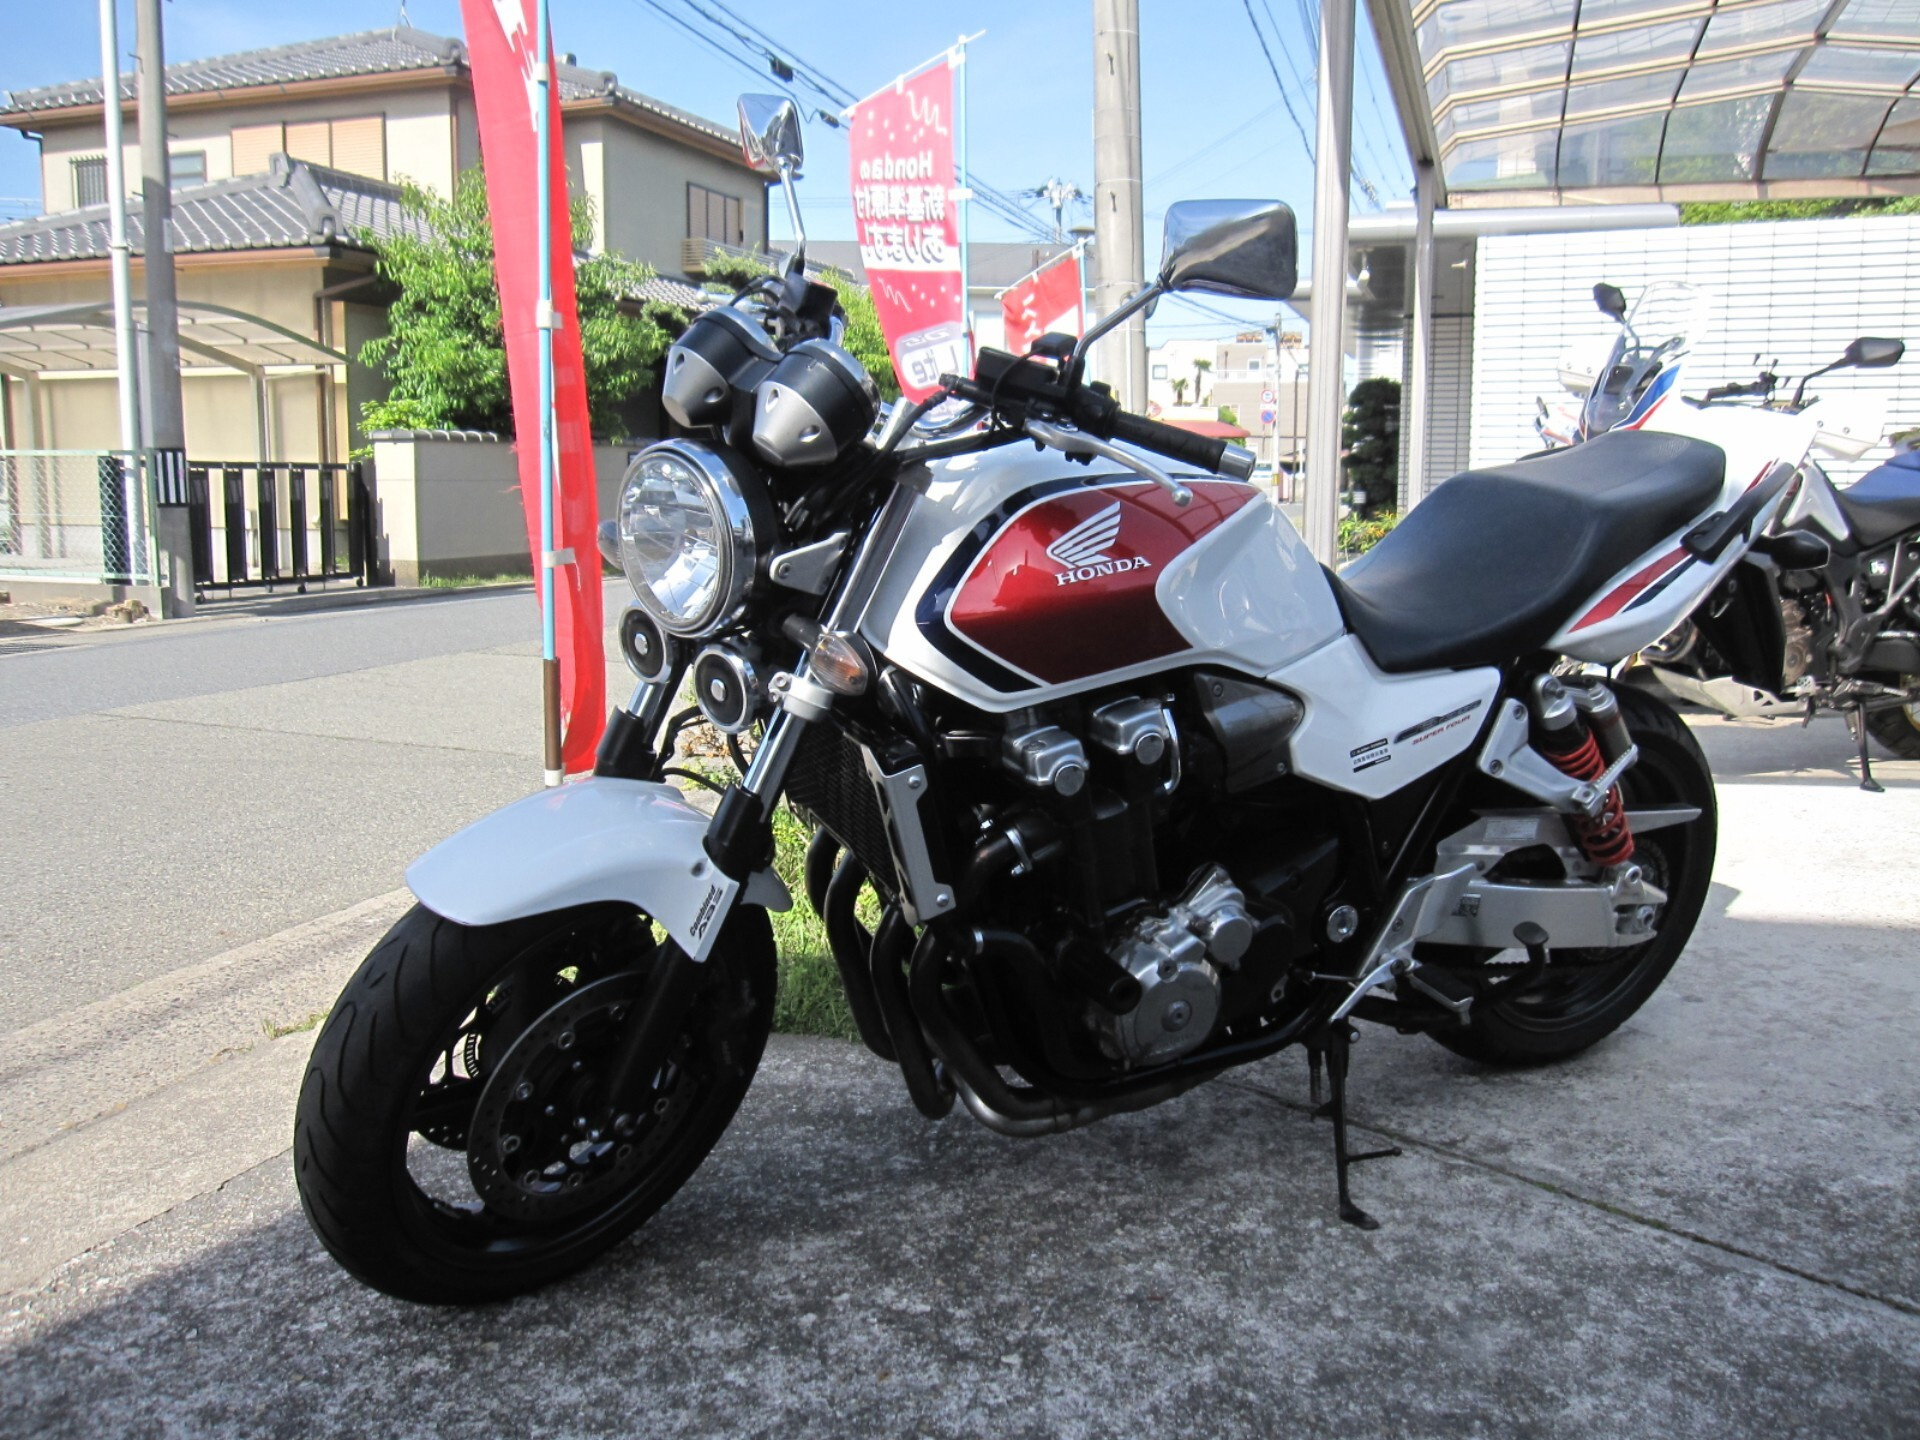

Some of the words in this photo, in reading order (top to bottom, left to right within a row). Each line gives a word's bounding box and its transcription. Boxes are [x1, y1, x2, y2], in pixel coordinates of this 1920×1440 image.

[1055, 556, 1152, 586] HONDA
[1411, 727, 1445, 746] SUPER
[1445, 714, 1471, 731] FOUR
[689, 884, 716, 937] Combined
